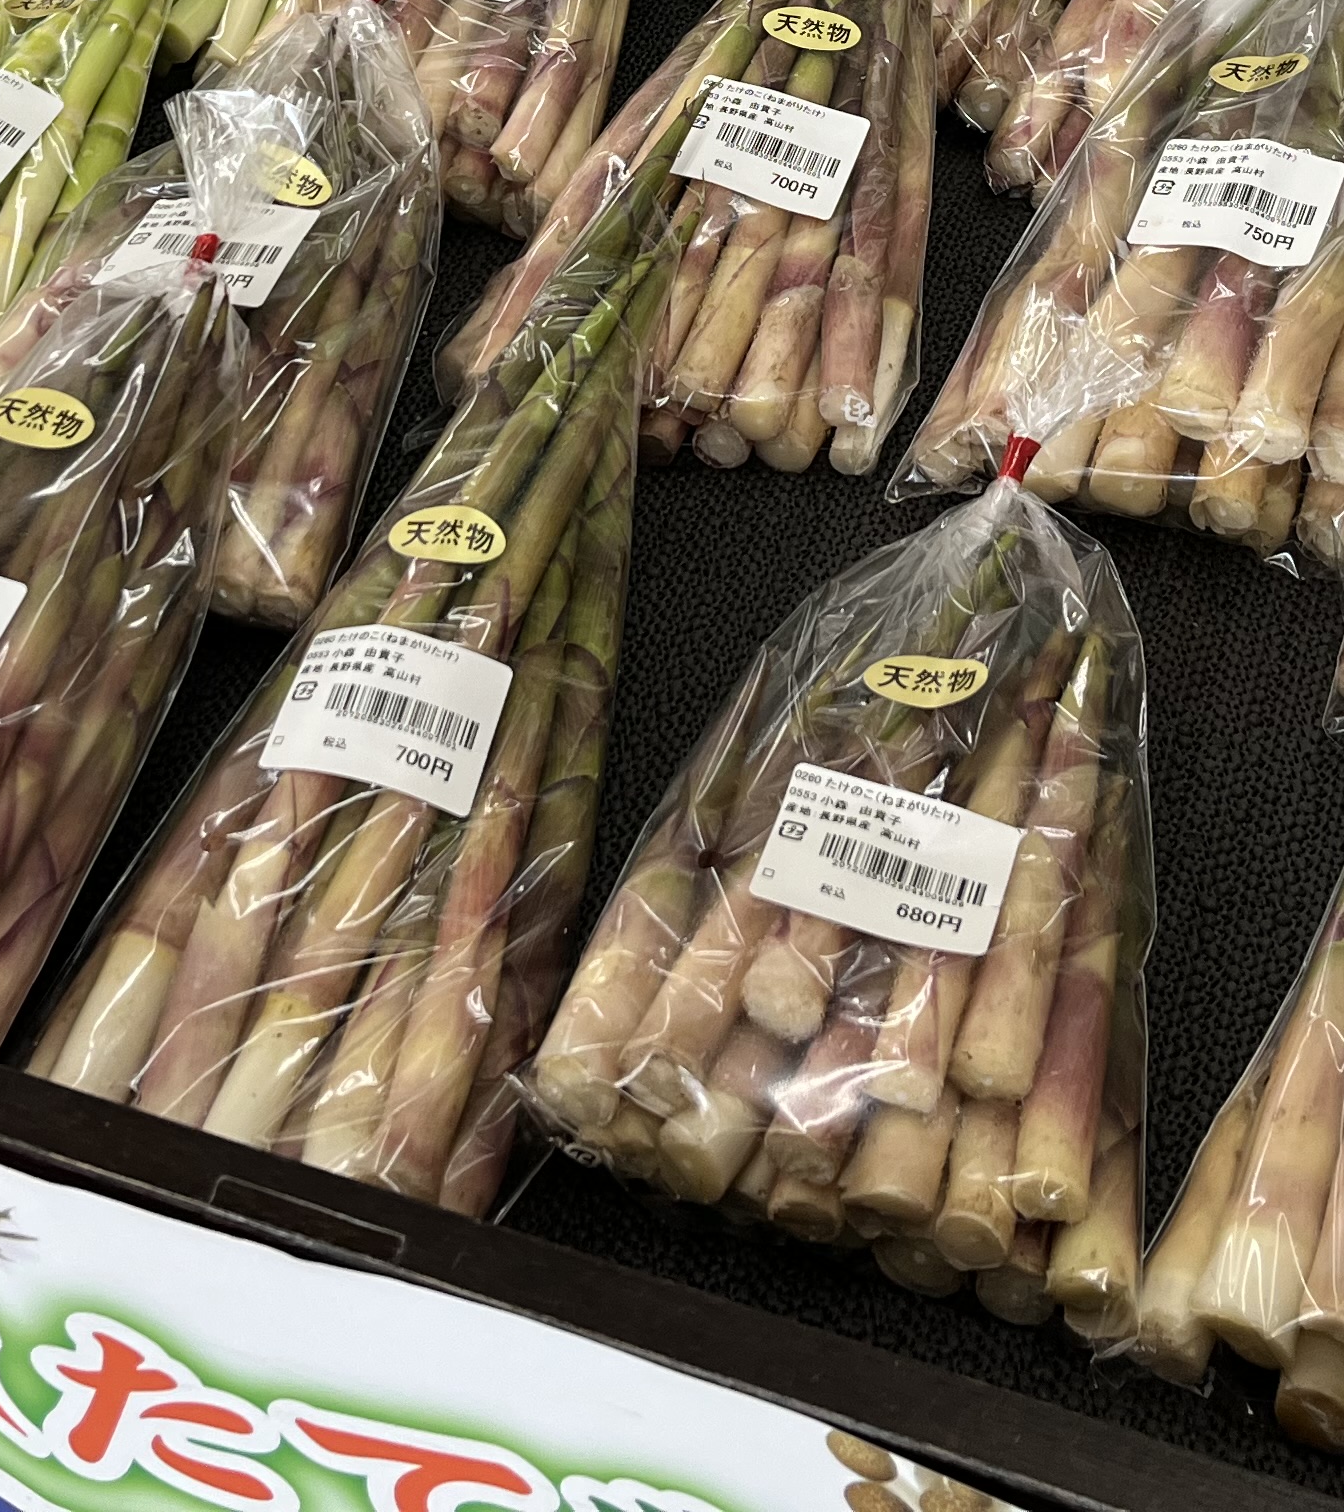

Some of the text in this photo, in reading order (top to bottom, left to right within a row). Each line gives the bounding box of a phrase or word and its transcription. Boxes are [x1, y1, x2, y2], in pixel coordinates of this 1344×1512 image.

[773, 13, 852, 45] 天然物
[1219, 57, 1303, 83] 天然物
[769, 172, 818, 199] 700円
[1243, 221, 1295, 251] 750円
[401, 518, 496, 555] 天然物
[877, 664, 978, 694] 天然物
[395, 743, 454, 782] 700円
[794, 769, 823, 785] 0260
[820, 794, 849, 810] 小森
[879, 827, 921, 851] 高山村
[896, 902, 963, 933] 680円
